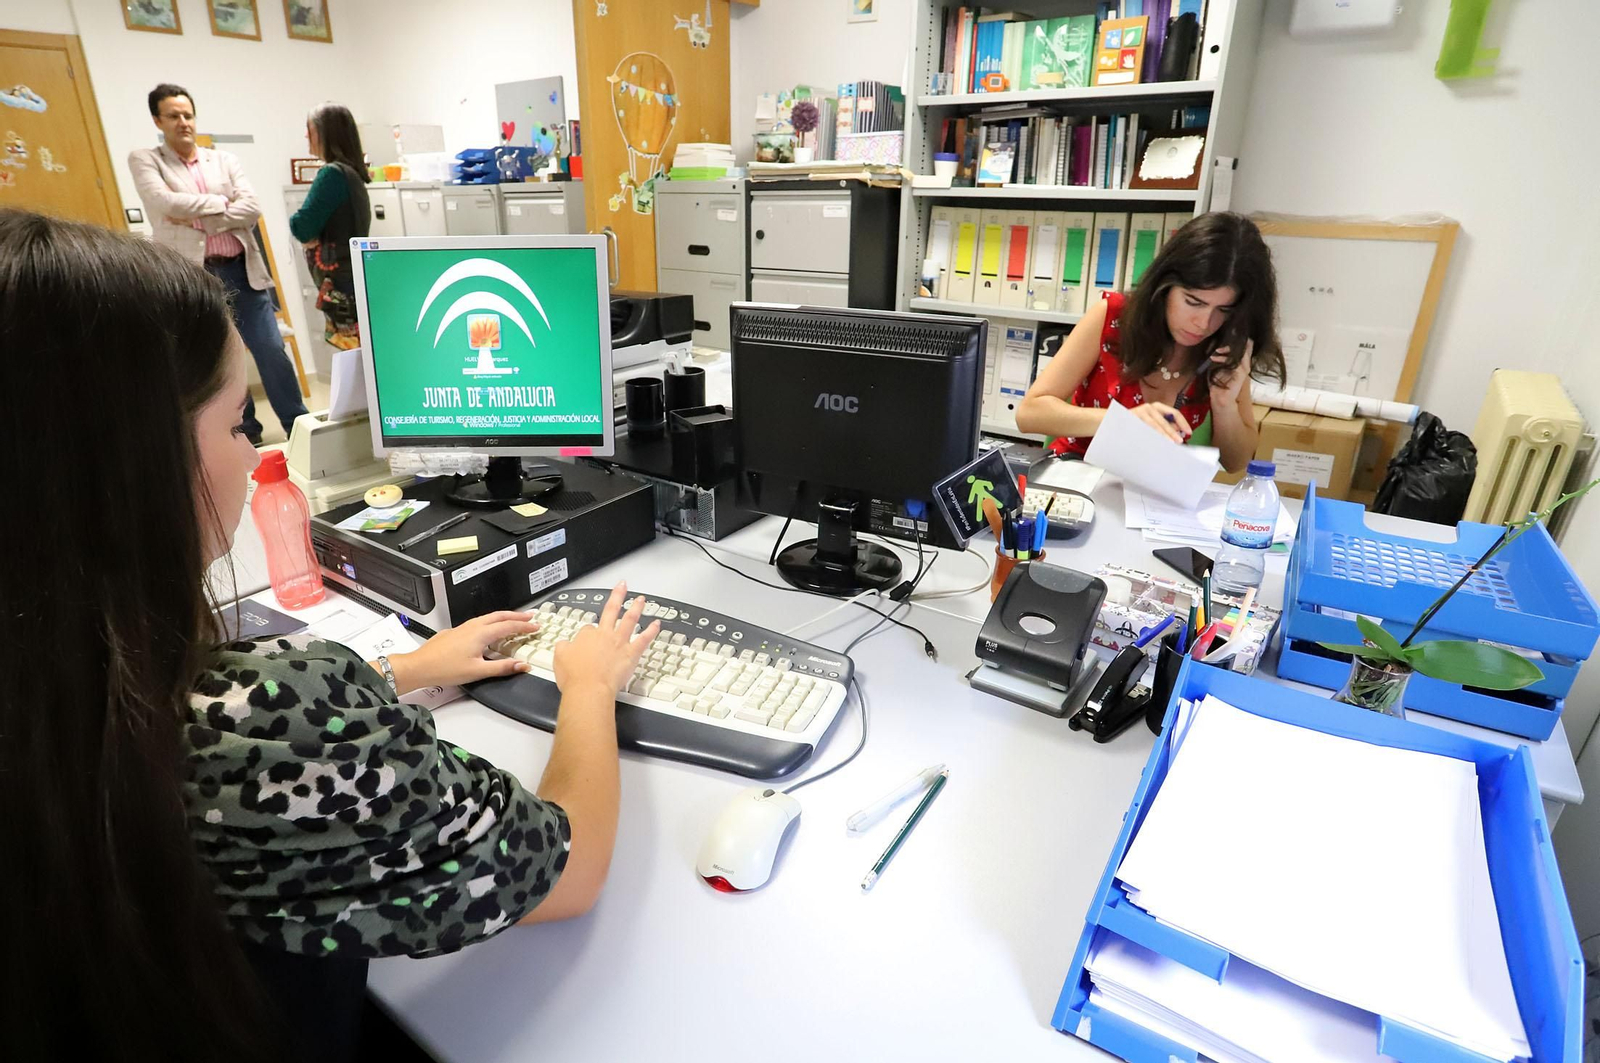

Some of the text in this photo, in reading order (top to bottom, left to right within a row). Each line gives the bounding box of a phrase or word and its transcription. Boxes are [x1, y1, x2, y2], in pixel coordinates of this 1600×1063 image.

[422, 386, 556, 408] JUNTA DE ANDALUCIA
[814, 393, 859, 414] AOC
[384, 414, 418, 425] CONSEJERÍA
[419, 415, 427, 424] DE
[503, 415, 526, 423] JUSTICIA
[526, 415, 531, 423] Y
[531, 412, 581, 423] ADMINISTRACIÓN
[581, 414, 600, 423] LOCAL
[1232, 519, 1271, 532] Penacova
[807, 655, 842, 667] Microsoft
[712, 863, 735, 876] Microsoft
